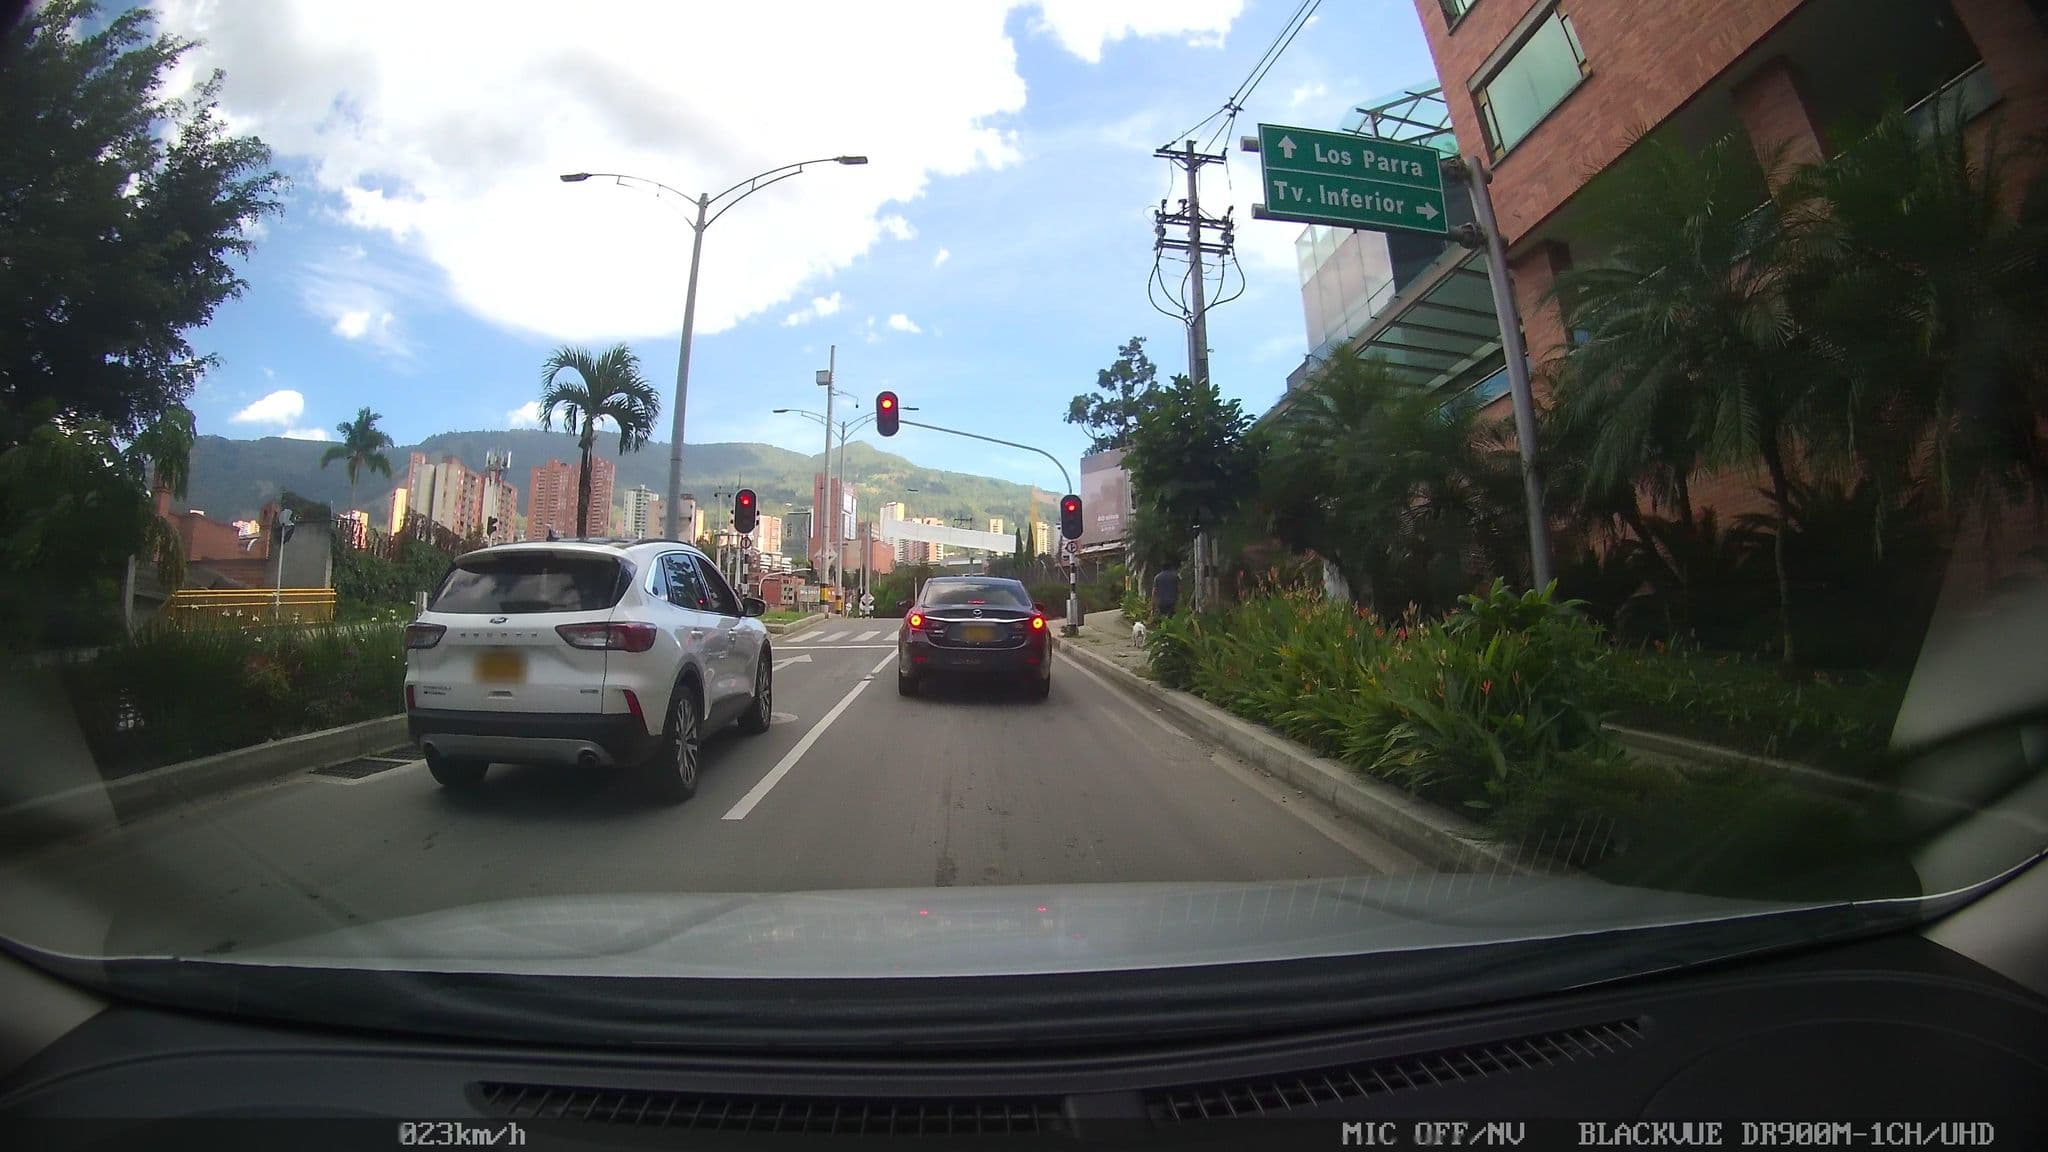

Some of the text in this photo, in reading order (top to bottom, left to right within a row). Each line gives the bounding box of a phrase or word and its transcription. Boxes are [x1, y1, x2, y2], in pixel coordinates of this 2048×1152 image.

[1314, 143, 1423, 177] Los Parra
[1273, 180, 1405, 215] Tv. Inferior
